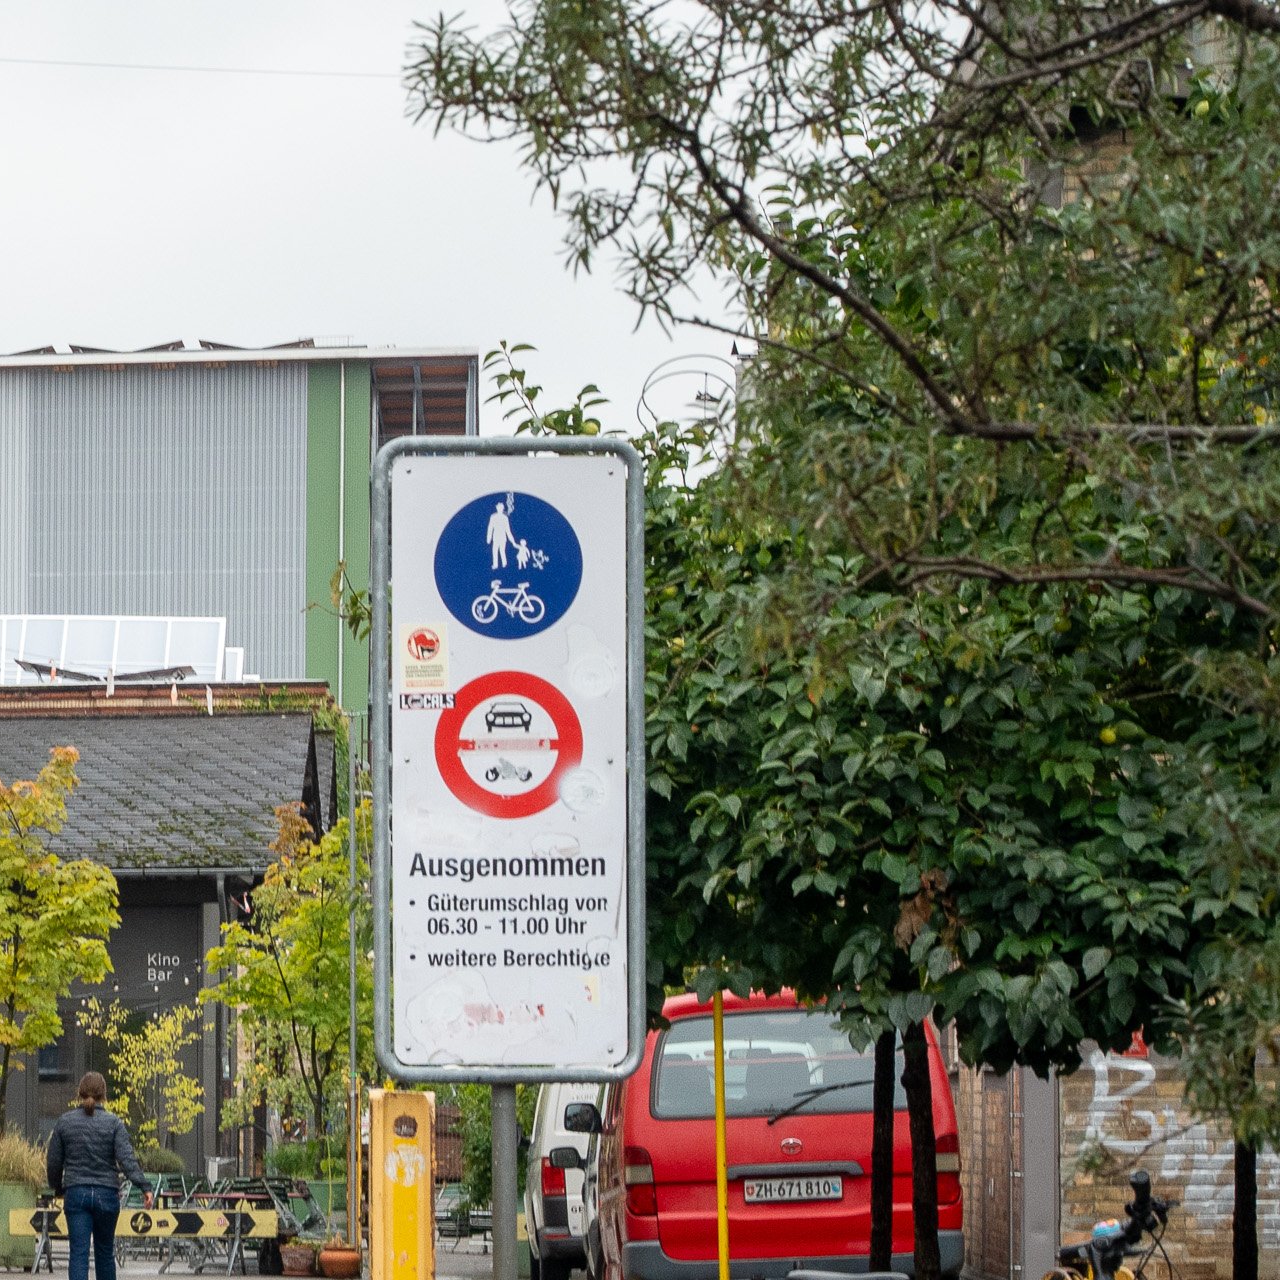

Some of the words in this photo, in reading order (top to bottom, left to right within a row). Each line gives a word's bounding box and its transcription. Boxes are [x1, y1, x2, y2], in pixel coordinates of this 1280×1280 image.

[409, 852, 607, 883] Ausgenommen
[427, 893, 569, 915] Güterumschlag
[575, 897, 609, 912] von
[427, 917, 479, 935] 06.30
[498, 917, 549, 935] 11.00
[555, 917, 588, 935] Uhr
[147, 952, 180, 966] Kino
[427, 949, 498, 967] weitere
[147, 967, 172, 981] Bar
